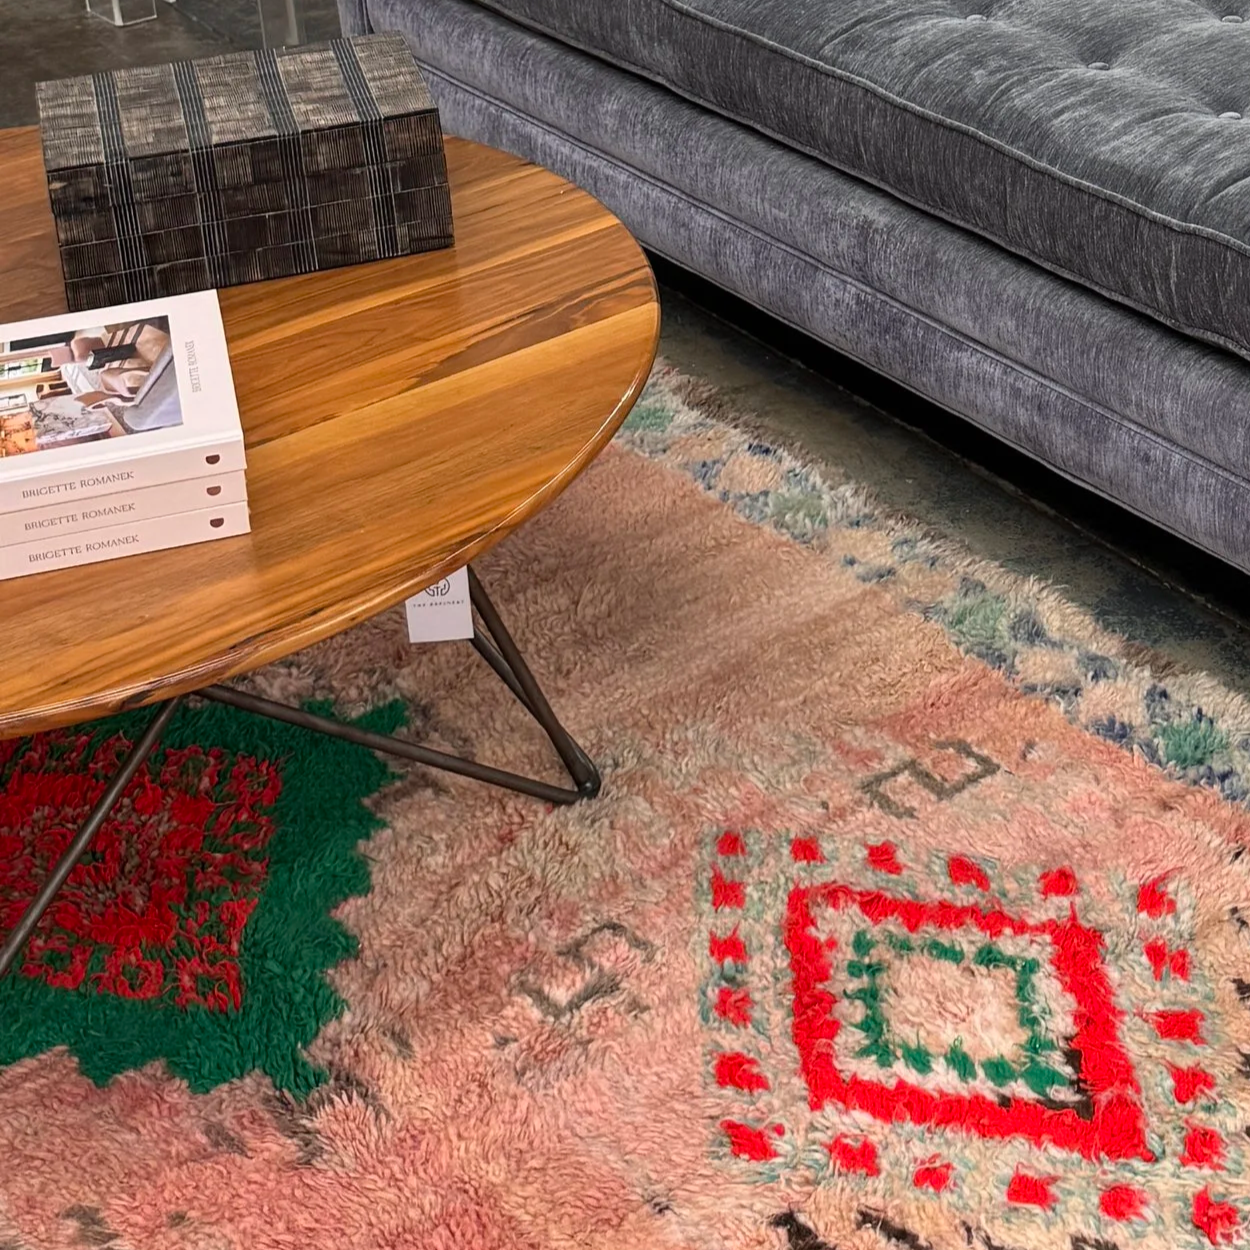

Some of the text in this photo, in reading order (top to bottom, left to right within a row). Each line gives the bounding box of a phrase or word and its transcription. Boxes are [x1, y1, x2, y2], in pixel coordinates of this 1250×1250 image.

[22, 471, 135, 499] BRIGETTE ROMANEK
[24, 503, 136, 531] BRIGETTE ROMANEK
[28, 534, 140, 563] BRIGETTE ROMANEK
